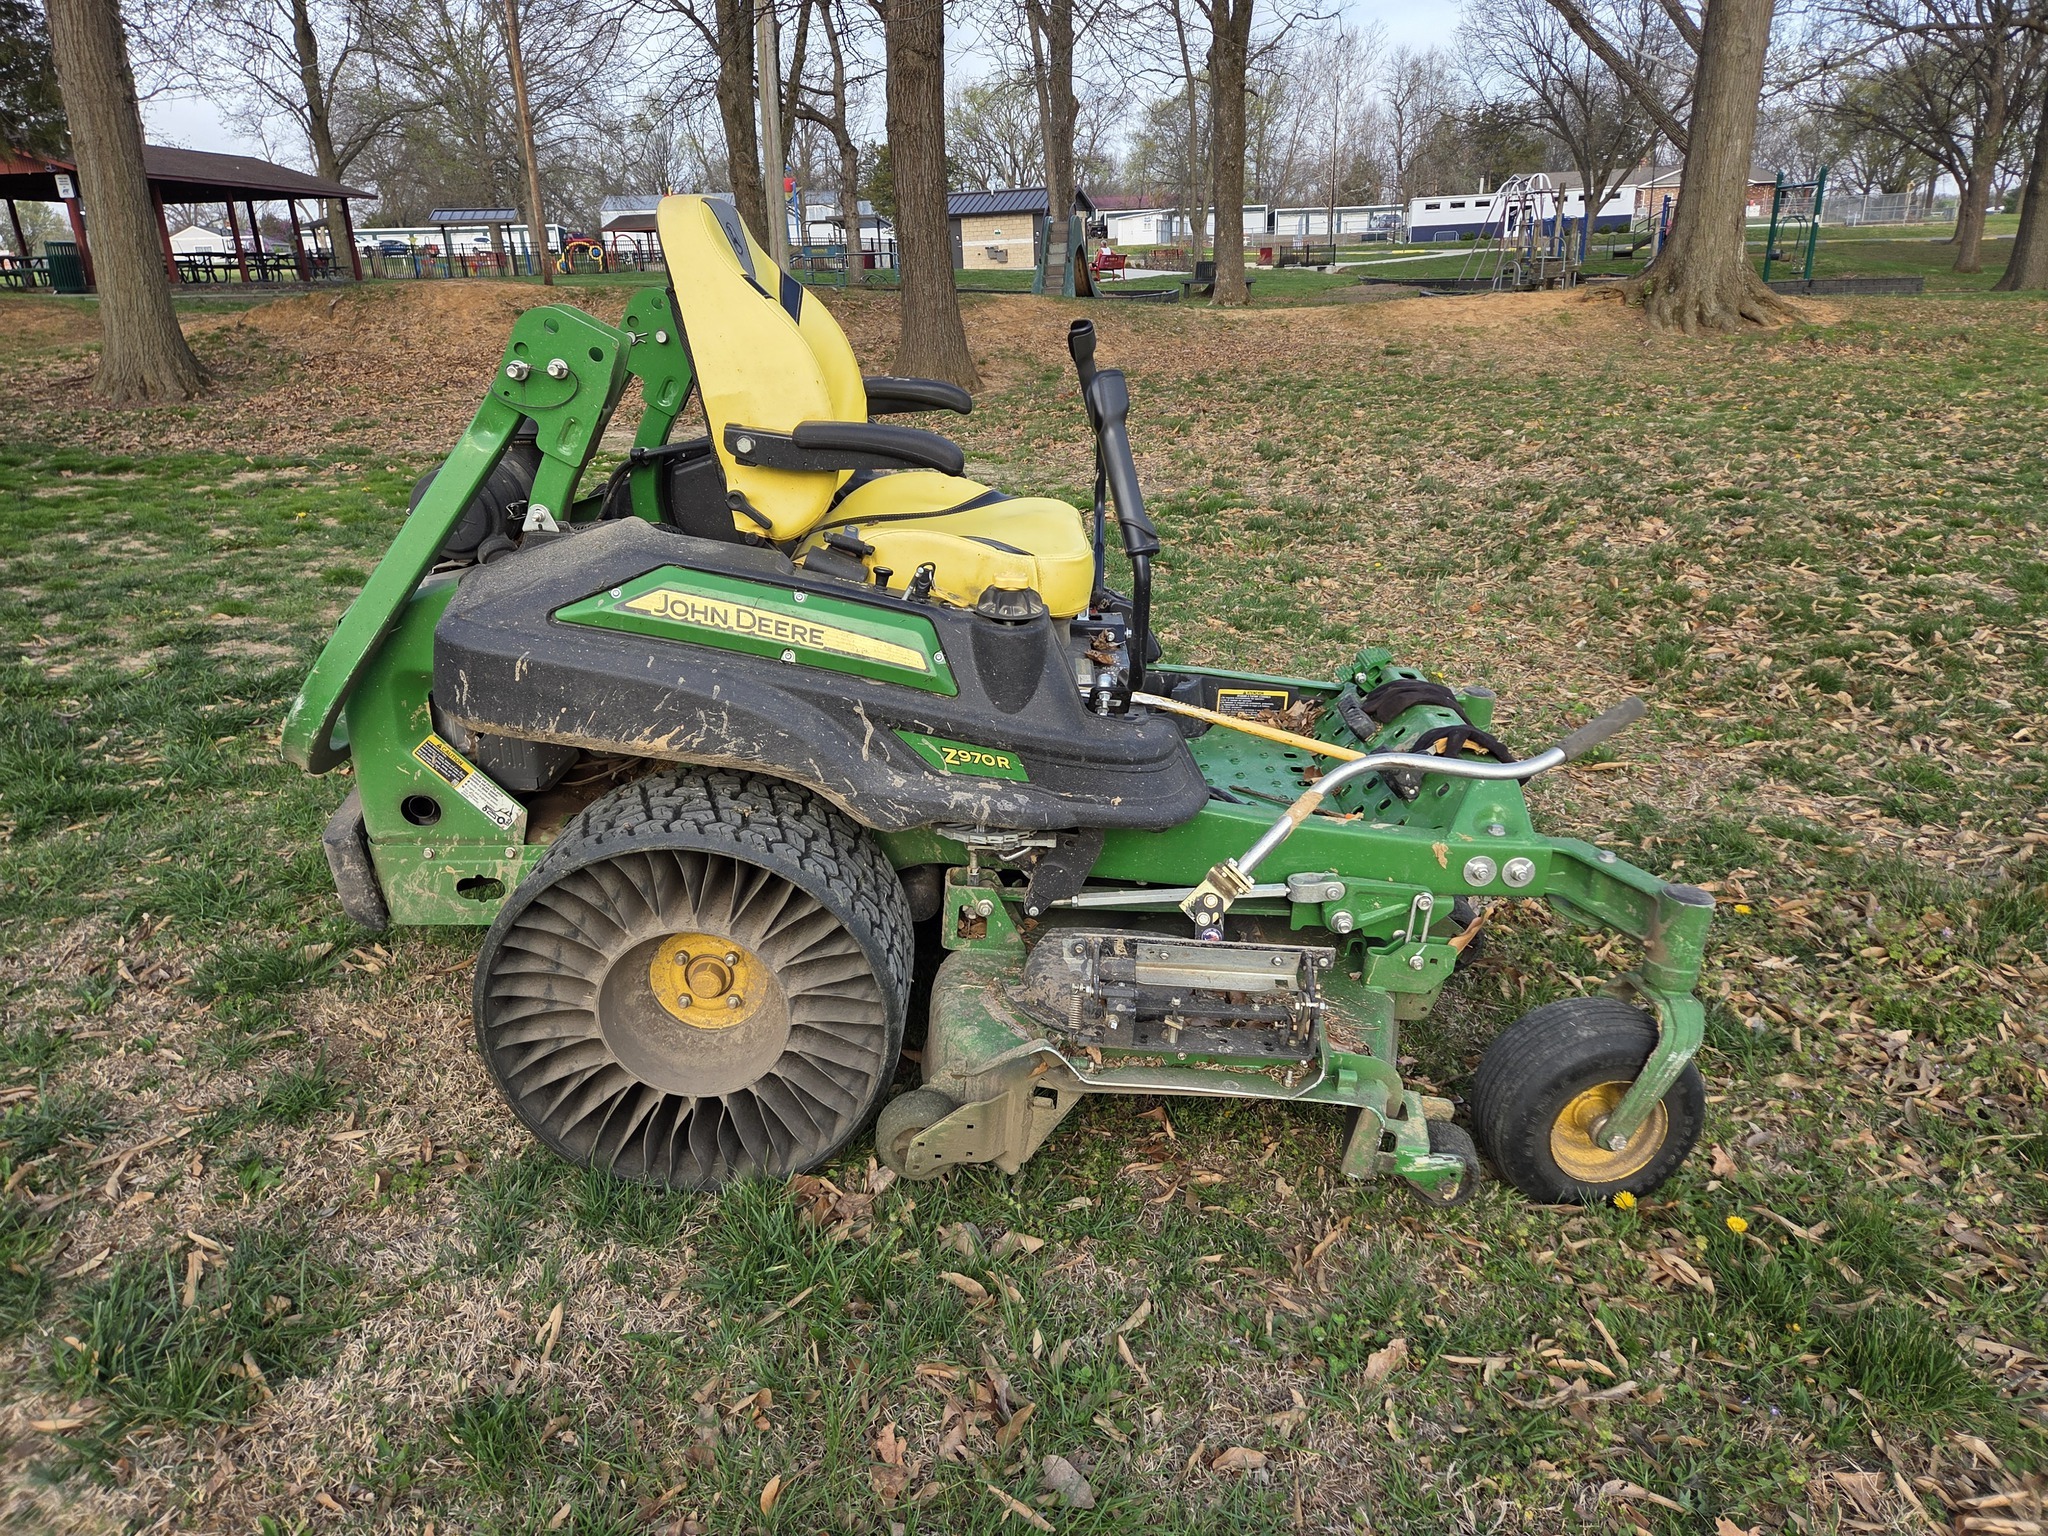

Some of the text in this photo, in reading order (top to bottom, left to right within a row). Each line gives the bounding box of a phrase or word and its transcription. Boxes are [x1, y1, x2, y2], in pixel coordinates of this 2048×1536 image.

[654, 594, 827, 646] JOHN DEERE
[441, 746, 464, 766] CAUTION
[941, 745, 1012, 770] Z970R
